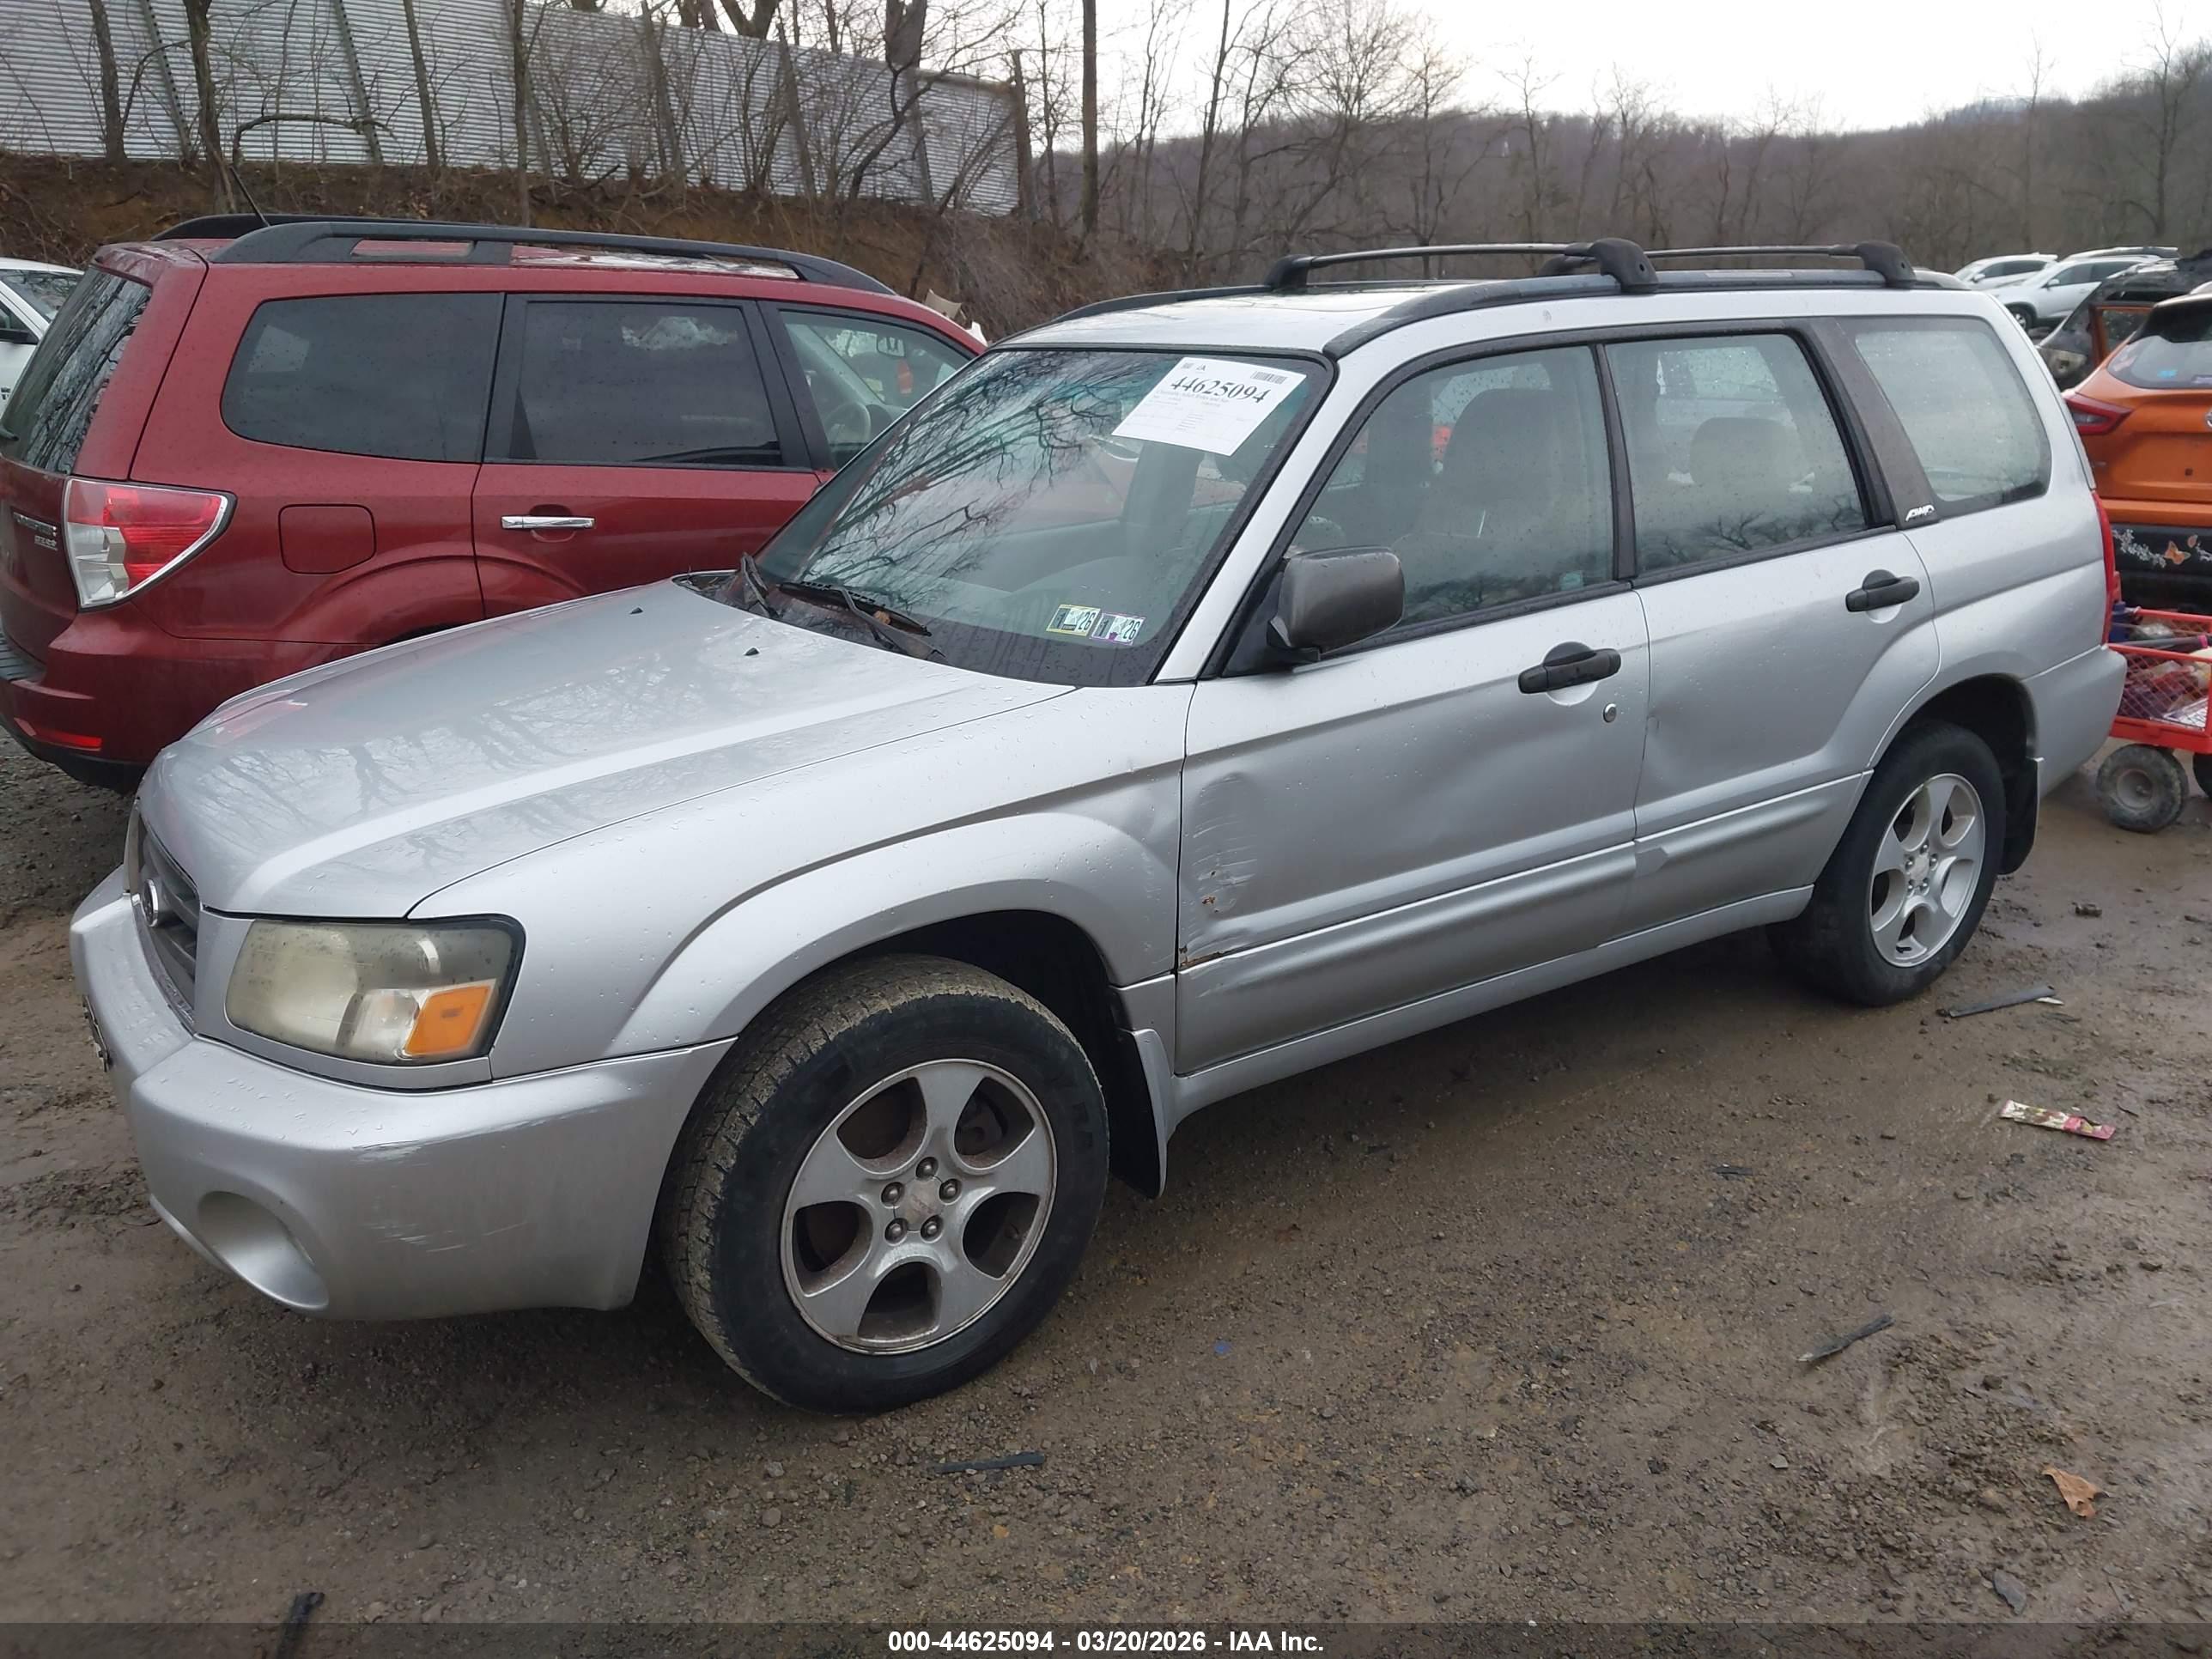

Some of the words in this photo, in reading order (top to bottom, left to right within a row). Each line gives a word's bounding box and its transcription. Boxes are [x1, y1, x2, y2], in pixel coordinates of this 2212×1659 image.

[1171, 376, 1272, 404] 44625094
[1078, 611, 1096, 630] 26
[1122, 620, 1141, 640] 26
